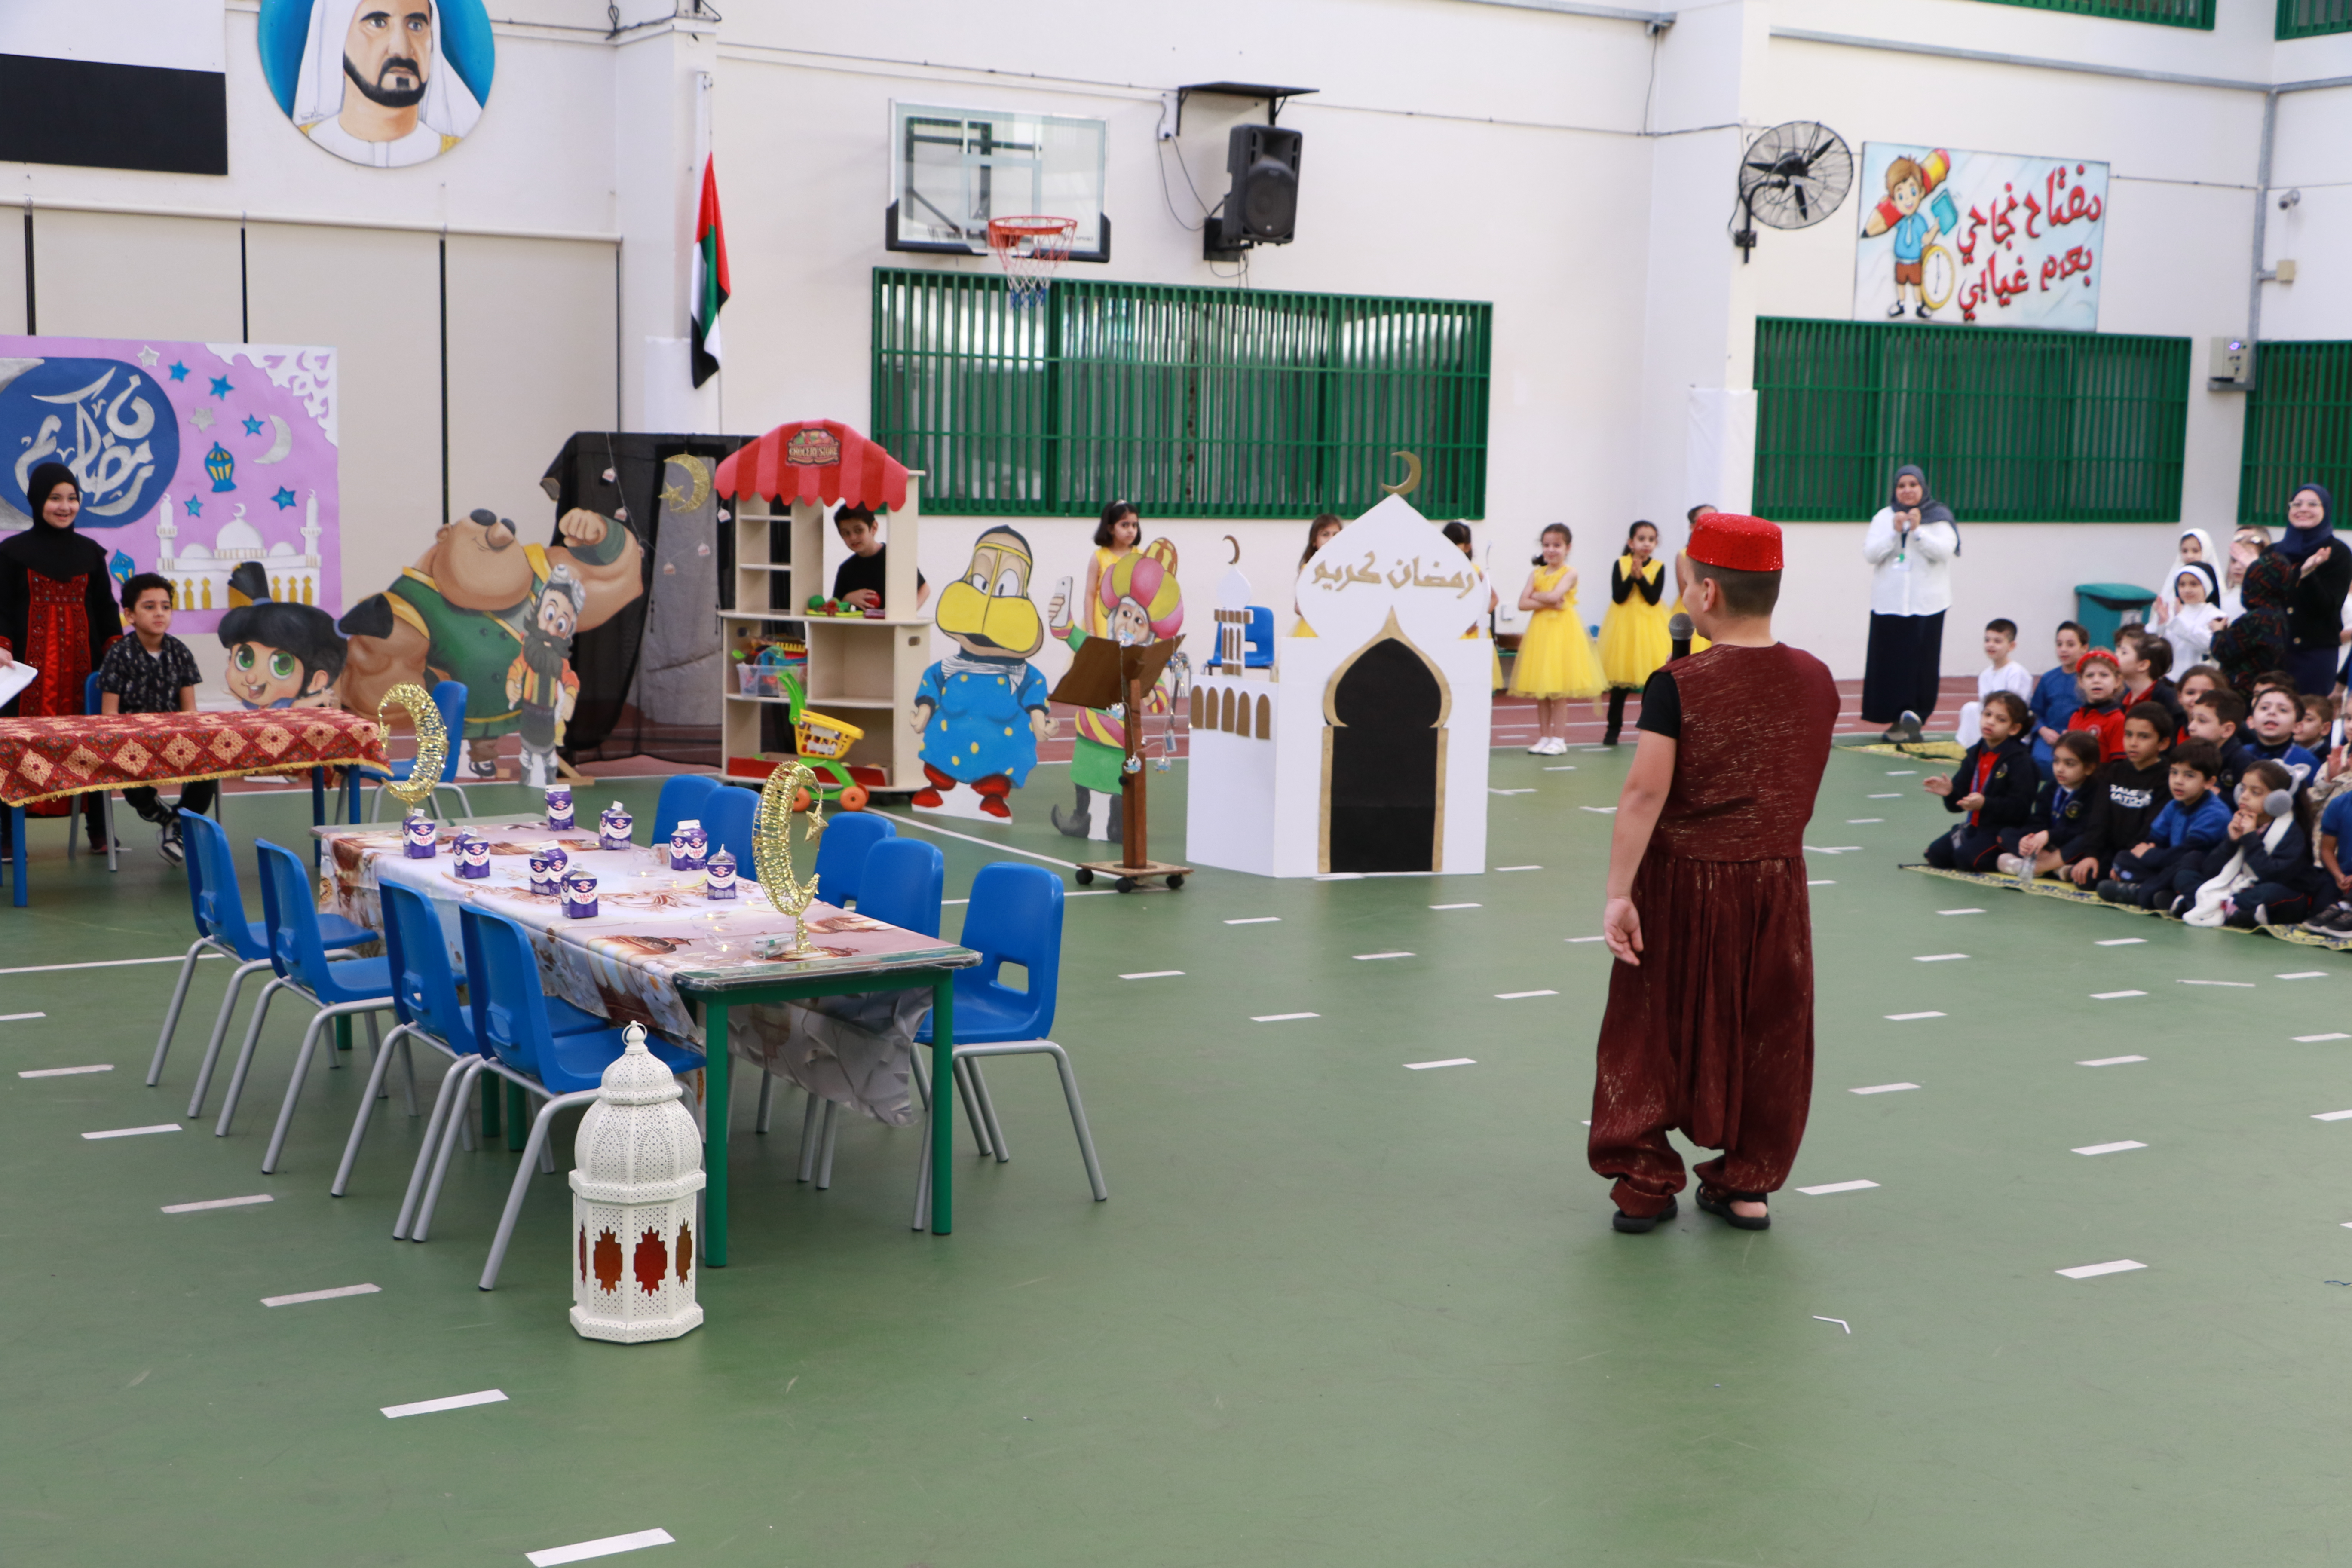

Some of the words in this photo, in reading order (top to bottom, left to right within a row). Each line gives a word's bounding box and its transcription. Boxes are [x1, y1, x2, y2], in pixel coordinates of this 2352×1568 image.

[1957, 182, 2018, 265] نجاحي
[2024, 164, 2102, 238] مفتاح
[1959, 251, 2029, 321] غيابي
[2040, 245, 2093, 291] بعدم
[788, 446, 818, 457] GROCERY
[818, 446, 838, 456] STORE
[1311, 551, 1382, 591] كريم
[1387, 555, 1476, 599] رمضان
